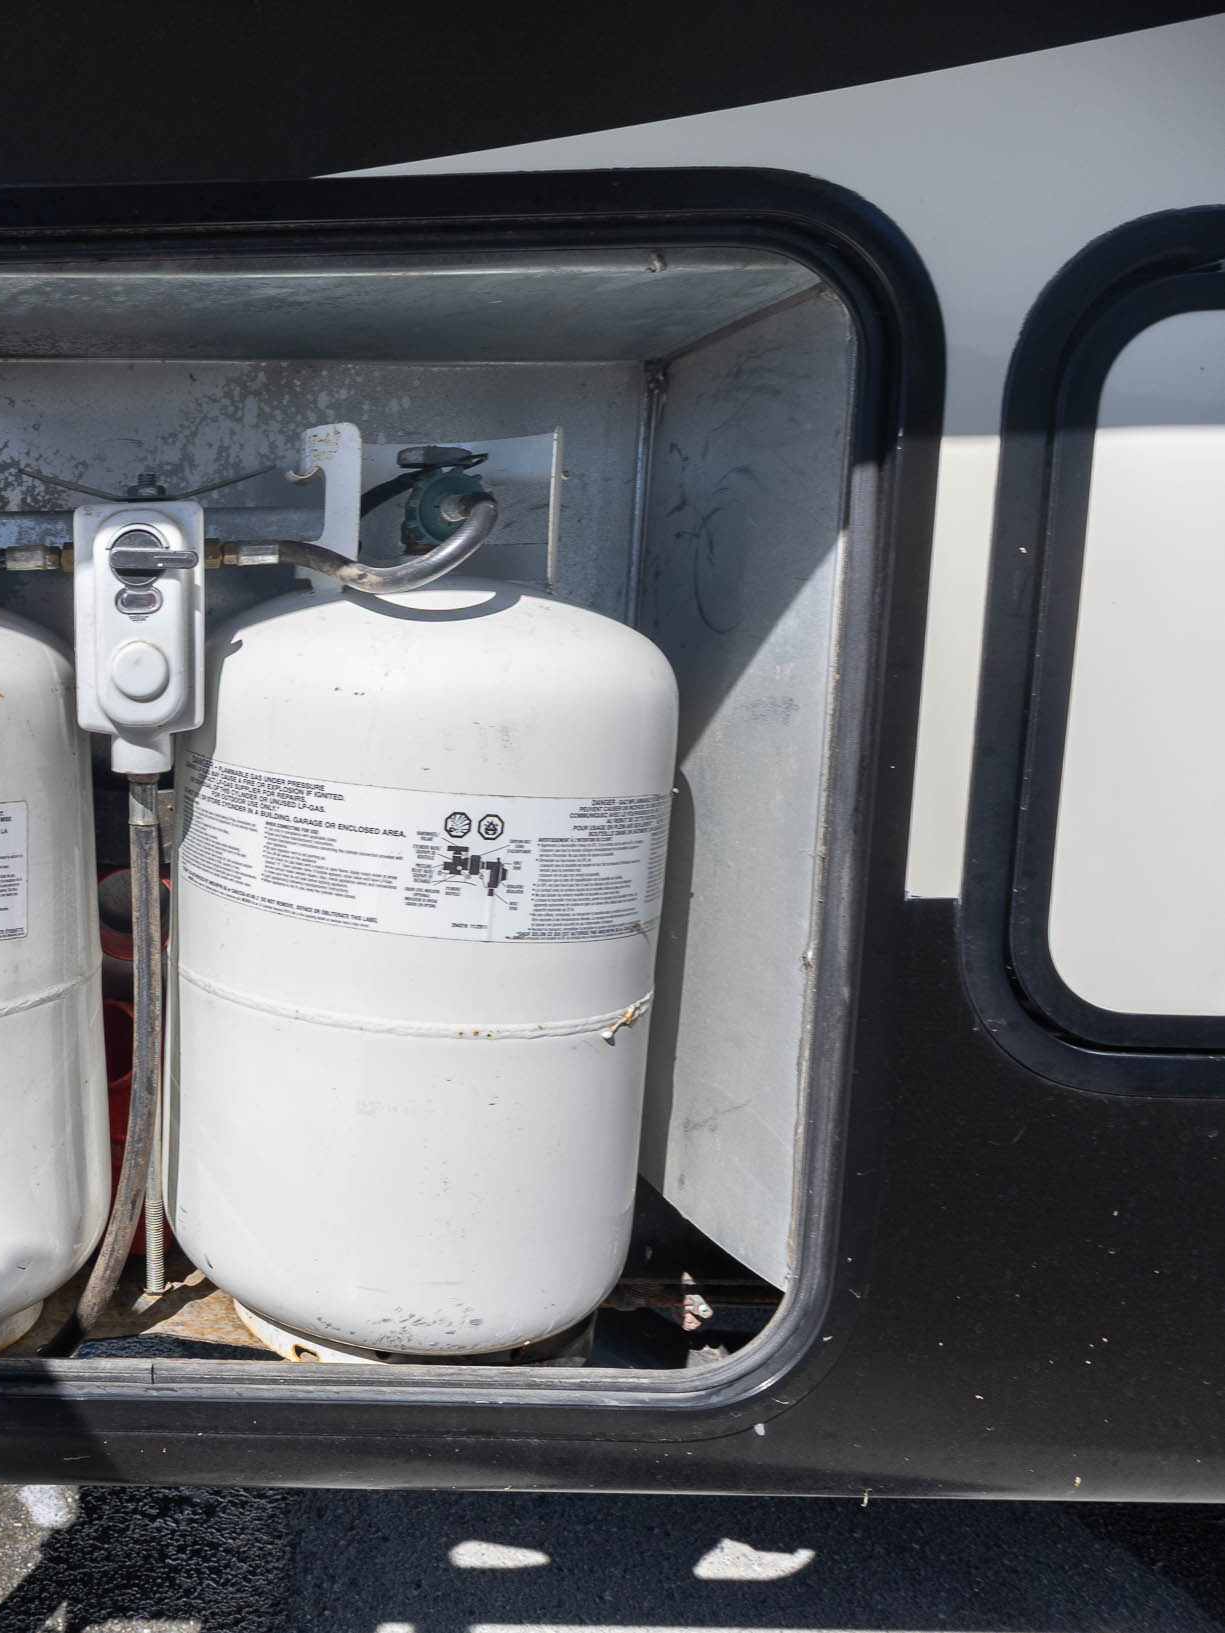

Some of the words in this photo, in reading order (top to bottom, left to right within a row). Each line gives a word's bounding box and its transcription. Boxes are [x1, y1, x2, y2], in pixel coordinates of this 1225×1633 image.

[267, 783, 304, 795] EXPLOSION
[287, 779, 325, 791] PRESSURE
[293, 816, 323, 828] GARAGE
[324, 821, 336, 829] OR
[337, 823, 380, 835] ENCLOSED
